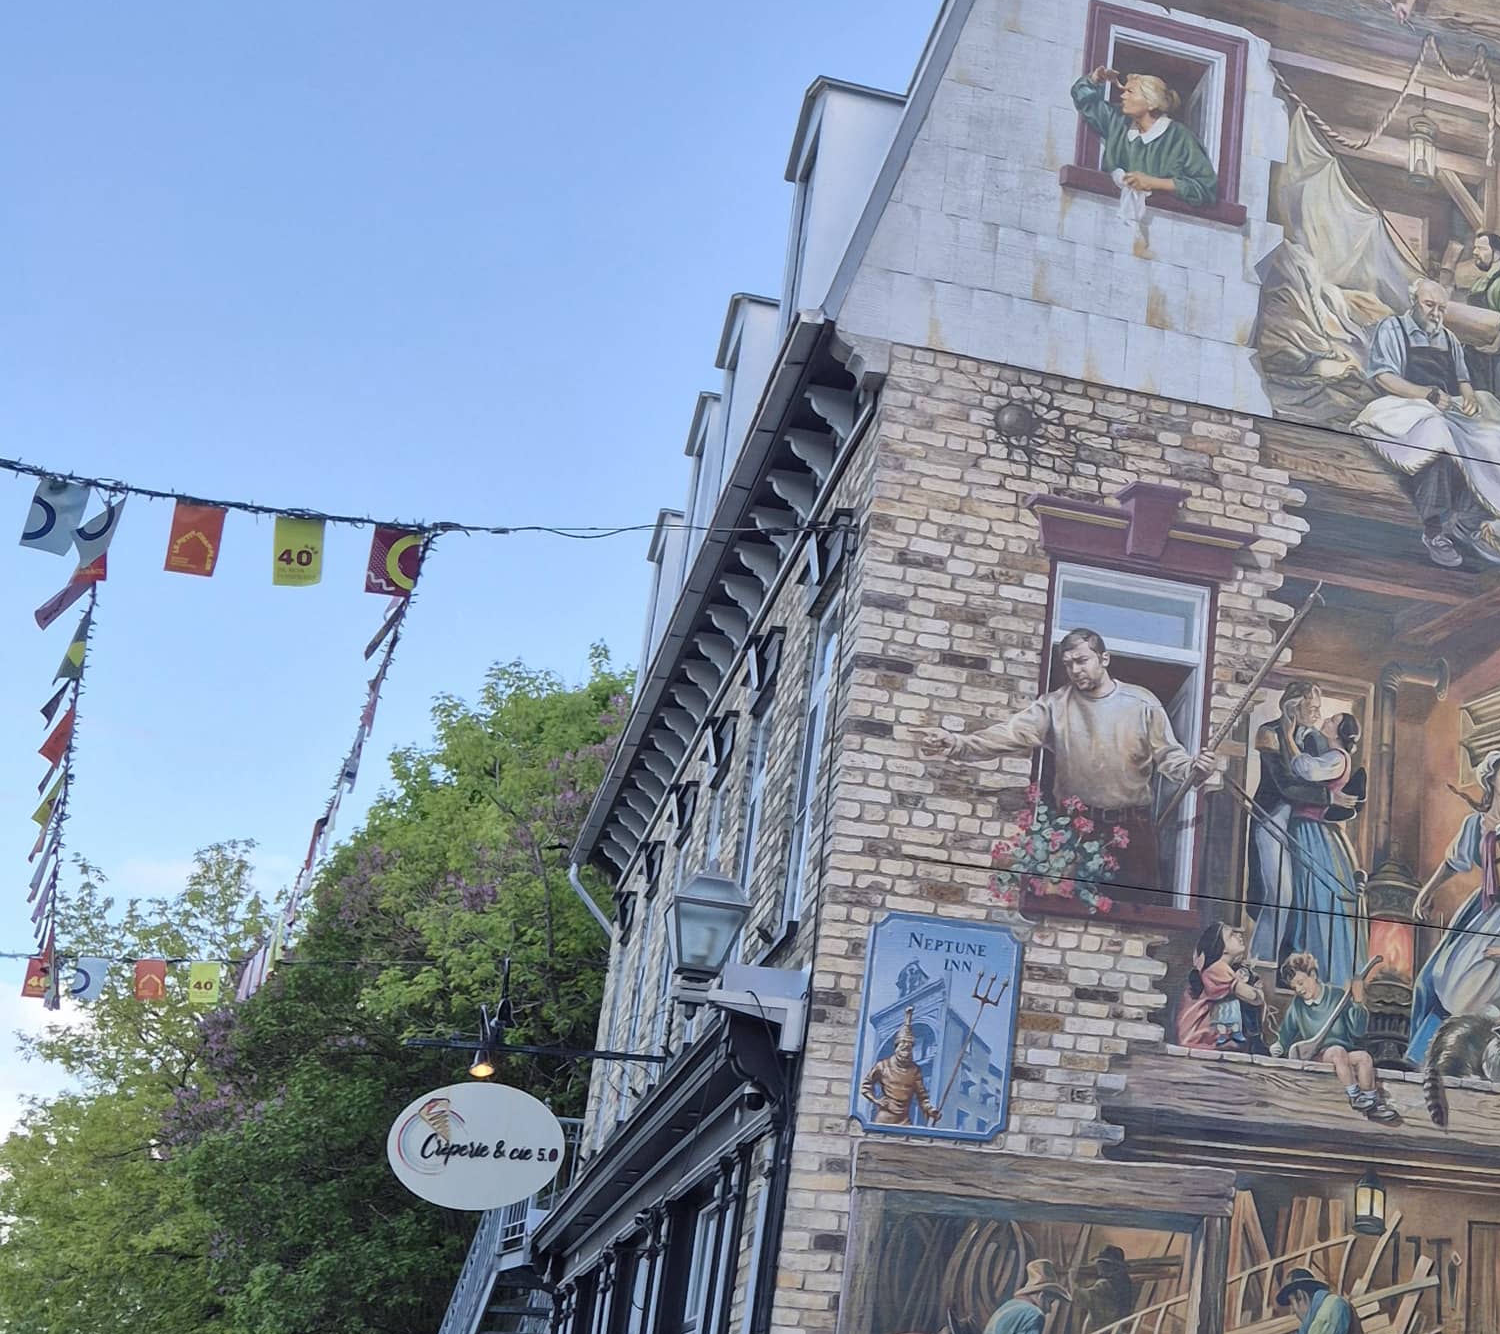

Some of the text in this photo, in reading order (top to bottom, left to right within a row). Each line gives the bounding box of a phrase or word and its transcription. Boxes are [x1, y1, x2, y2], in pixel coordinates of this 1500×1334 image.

[278, 549, 313, 566] 40
[908, 932, 987, 957] NEPTUNE
[944, 958, 972, 973] INN
[193, 981, 213, 990] 40
[493, 1140, 506, 1158] &
